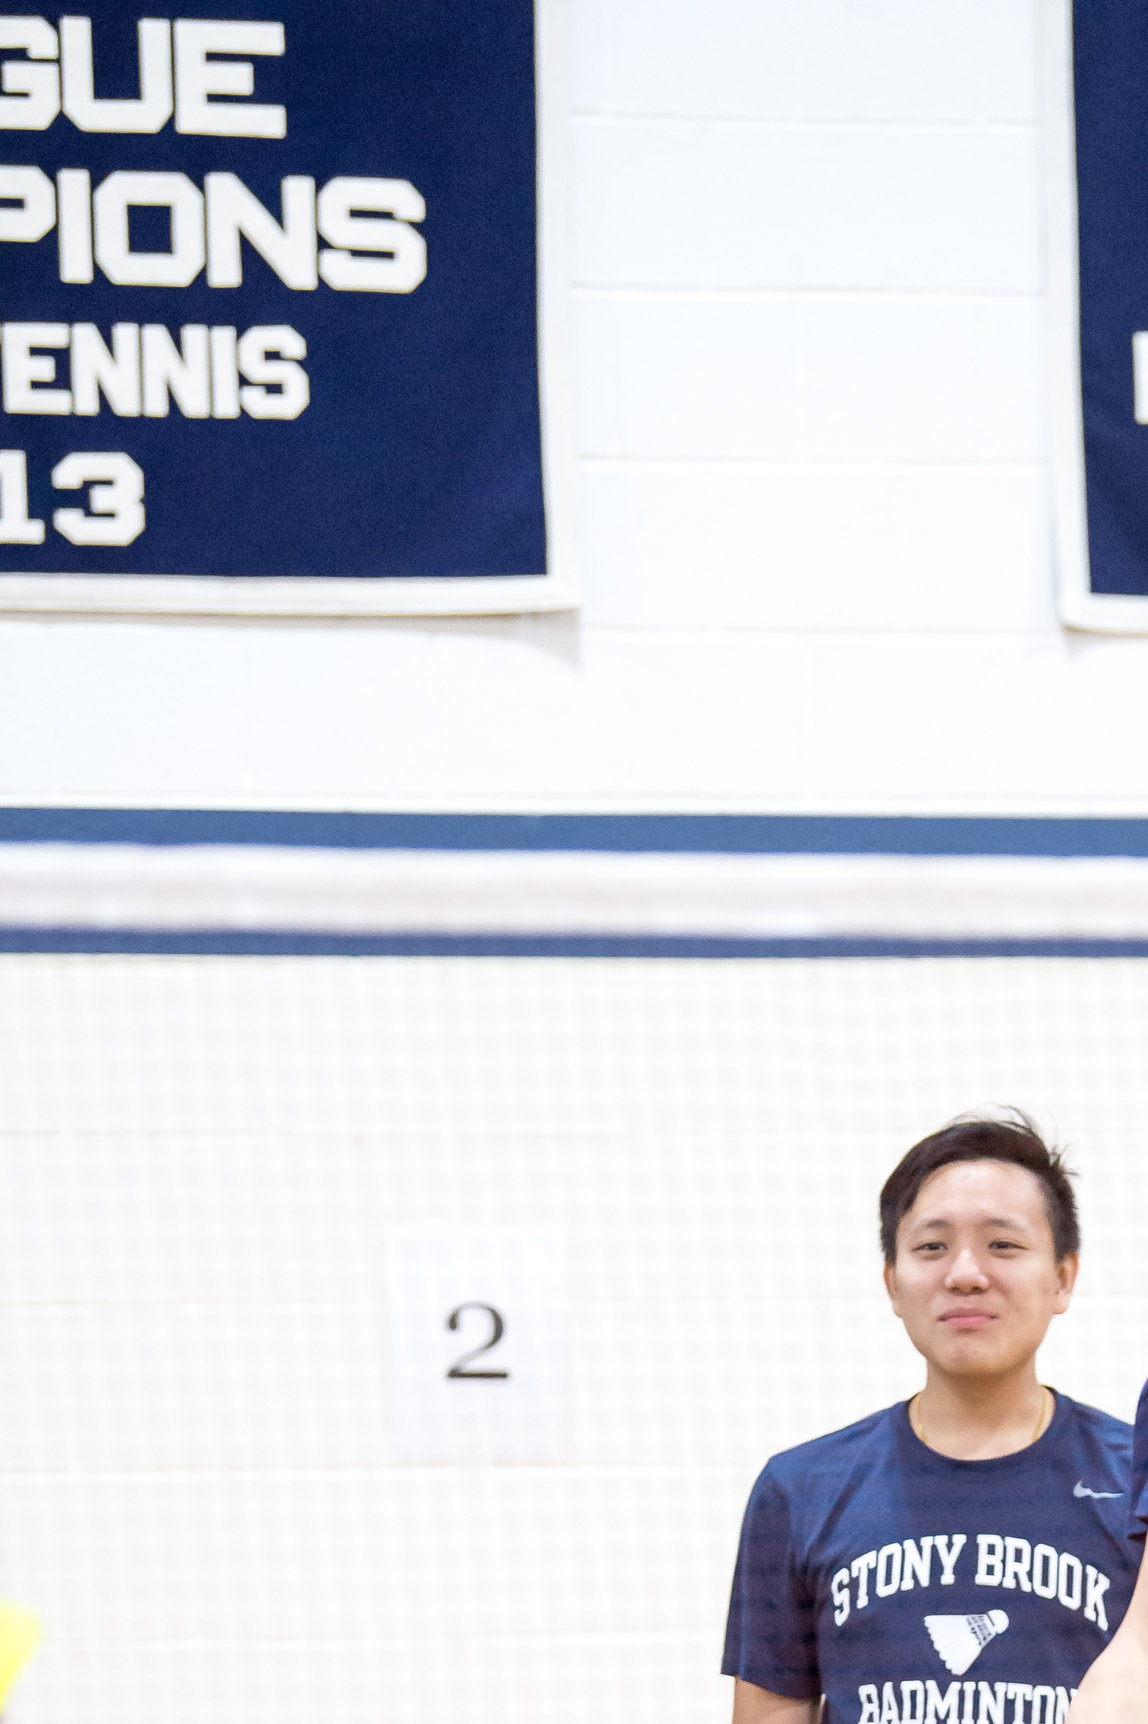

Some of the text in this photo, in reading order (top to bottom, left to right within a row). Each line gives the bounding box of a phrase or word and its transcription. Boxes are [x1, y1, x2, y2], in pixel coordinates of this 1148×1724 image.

[0, 322, 310, 420] ENNIS
[447, 1301, 509, 1379] 2
[831, 1534, 1110, 1632] STONY BROOK
